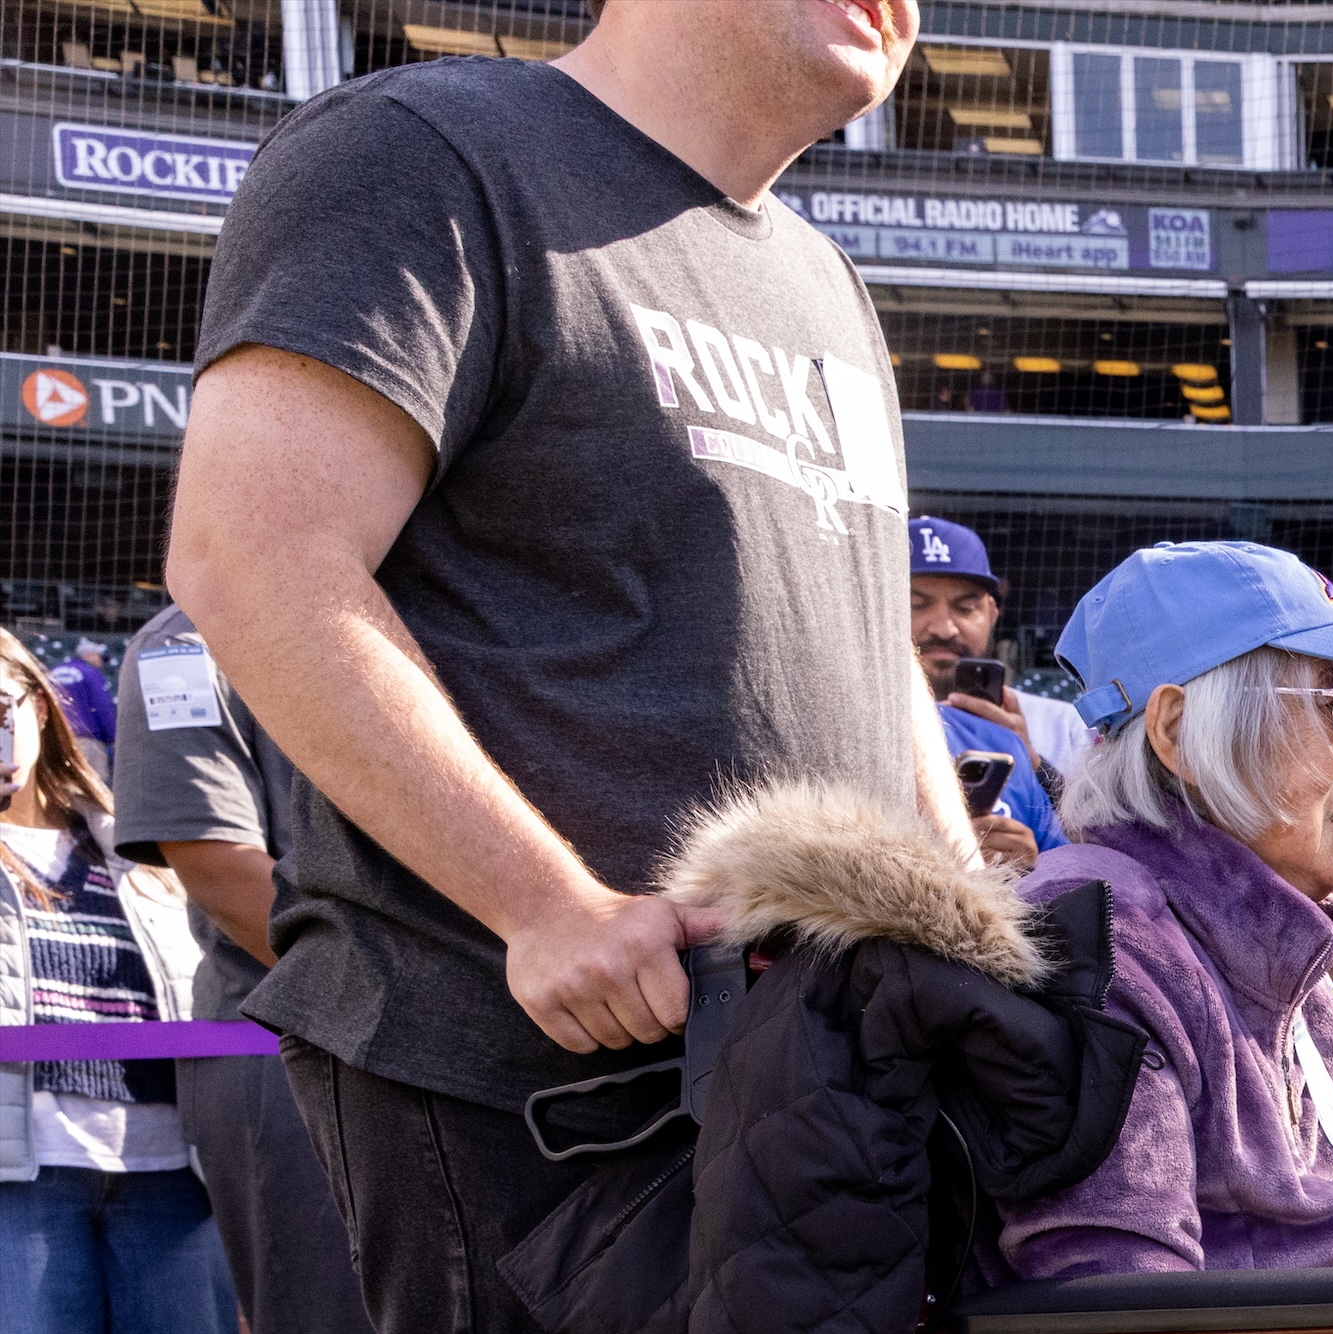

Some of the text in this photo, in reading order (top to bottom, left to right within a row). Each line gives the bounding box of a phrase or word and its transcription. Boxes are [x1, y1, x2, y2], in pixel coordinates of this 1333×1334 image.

[71, 138, 249, 193] ROCKIE
[811, 192, 1080, 233] OFFICIAL RADIO HOME
[1153, 214, 1205, 233] KOA
[946, 238, 978, 256] FM
[1011, 239, 1118, 268] iHeart app
[629, 303, 837, 455] ROCK
[91, 379, 189, 430] PN
[919, 528, 952, 563] LA
